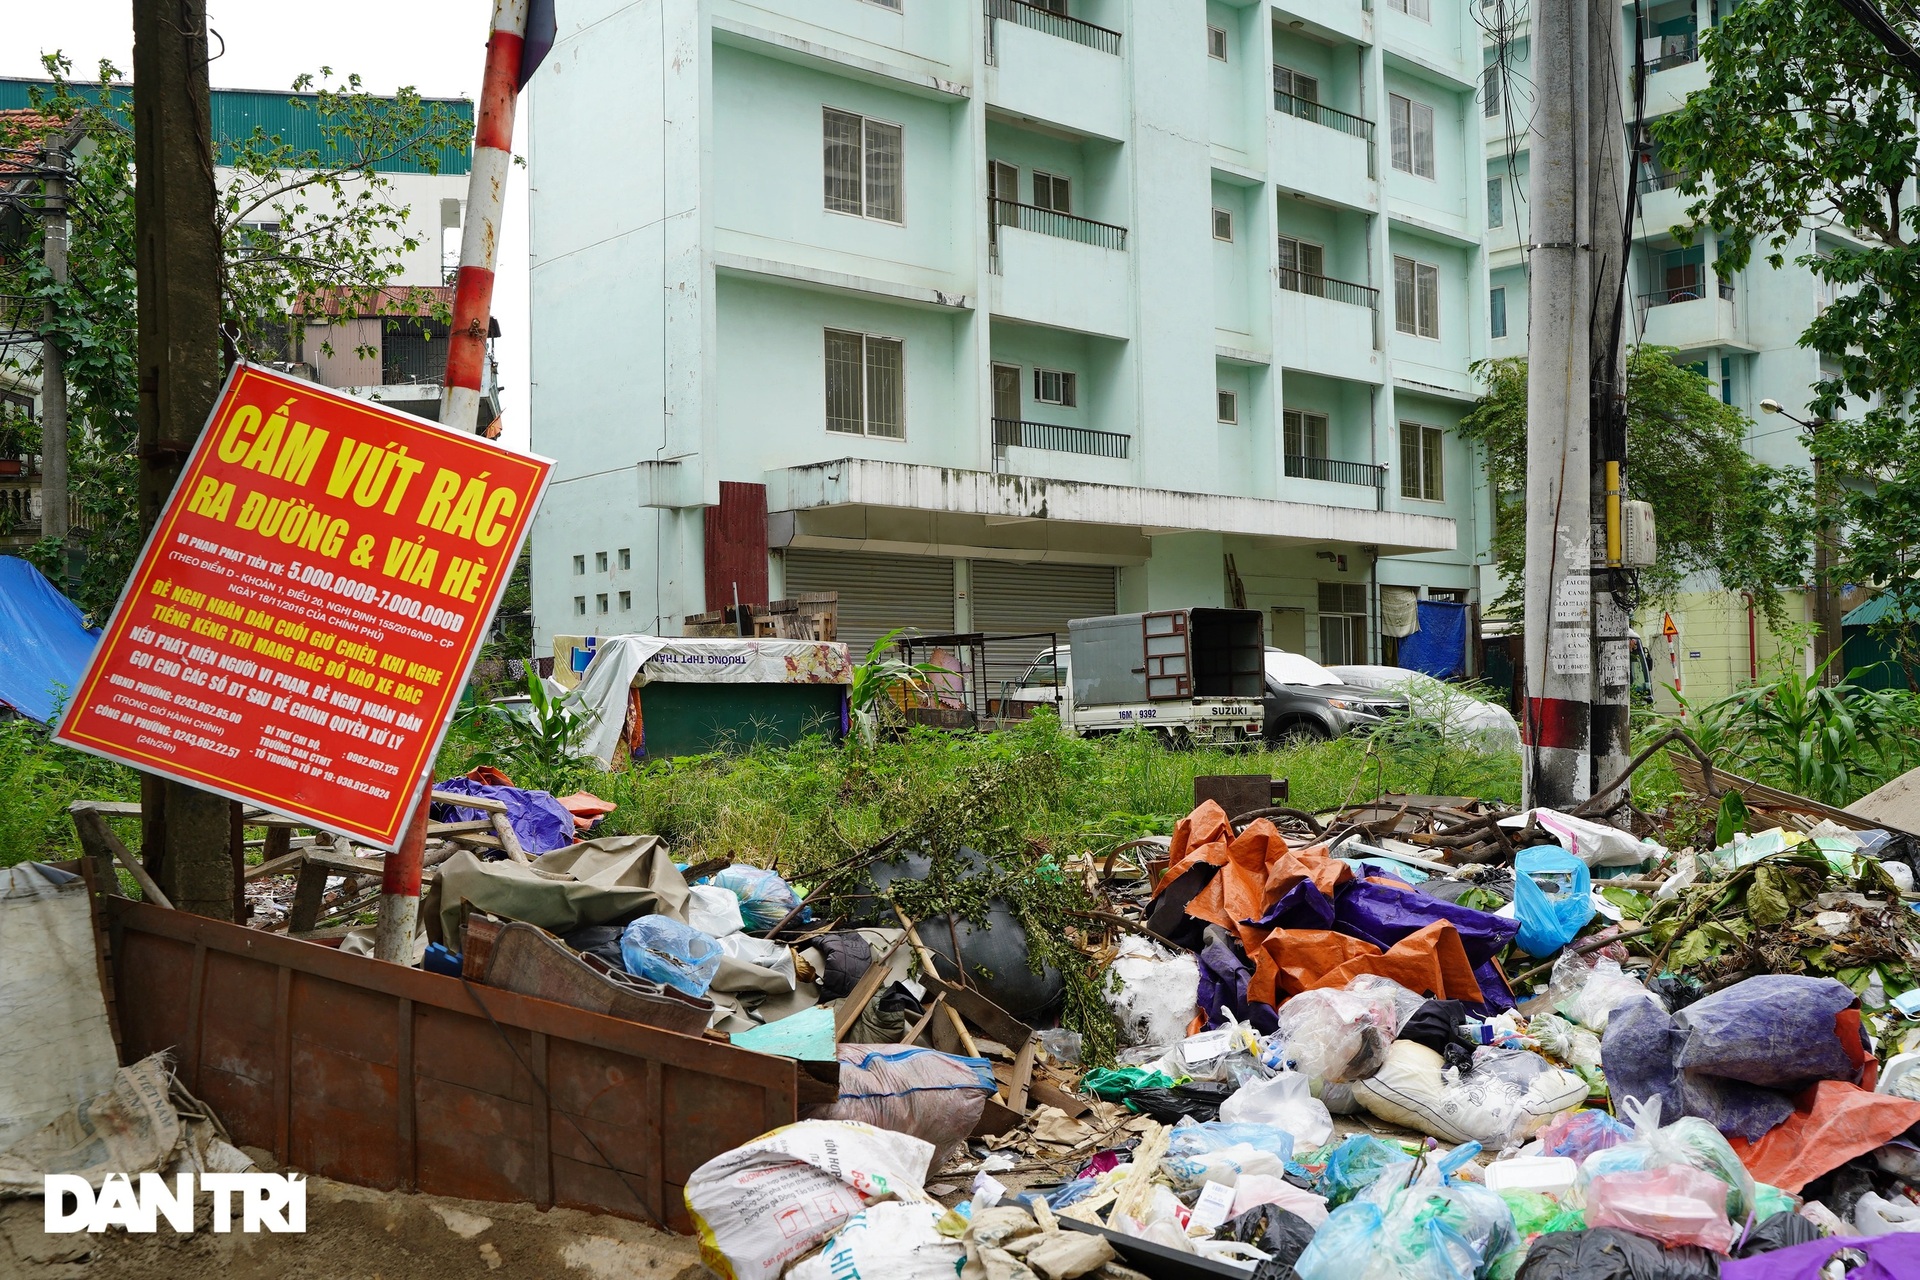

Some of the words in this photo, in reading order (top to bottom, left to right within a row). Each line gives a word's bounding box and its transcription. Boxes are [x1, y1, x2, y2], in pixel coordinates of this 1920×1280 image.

[217, 397, 330, 487] CẤM
[325, 436, 426, 516] VỨT
[415, 467, 518, 548] RÁC
[186, 475, 237, 523] RA
[234, 490, 350, 559] ĐƯỜNG
[349, 533, 376, 570] &
[381, 534, 440, 589] VỈA
[438, 555, 489, 604] HÈ
[168, 550, 200, 566] (THEO
[200, 560, 226, 575] ĐIỂM
[225, 568, 235, 578] D
[240, 573, 277, 591] KHOẢN
[277, 585, 285, 596] 1,
[286, 588, 312, 603] ĐIỀU
[310, 596, 324, 609] 20,
[326, 601, 352, 618] NGHỊ
[351, 609, 378, 624] ĐỊNH
[378, 618, 434, 642] 155/2016/NĐ
[439, 638, 455, 649] CP
[176, 532, 190, 545] VI
[188, 536, 219, 555] PHẠM
[217, 546, 246, 563] PHẠT
[245, 554, 269, 571] TIỀN
[287, 560, 465, 633] 5.000.000Đ-7.000.000Đ
[150, 577, 172, 598] ĐỀ
[170, 585, 207, 612] NGHỊ
[205, 596, 246, 622] NHÂN
[243, 609, 275, 632] DÂN
[274, 619, 310, 643] CUỐI
[335, 639, 378, 667] CHIỀU,
[379, 653, 407, 675] KHI
[405, 661, 444, 687] NGHE
[227, 583, 258, 599] NGÀY
[258, 593, 306, 615] 18/11/2016
[305, 608, 326, 622] CỦA
[327, 616, 360, 633] CHÍNH
[359, 626, 385, 643] PHỦ)
[151, 603, 192, 629] TIẾNG
[190, 616, 229, 642] KẺNG
[228, 628, 255, 650] THÌ
[252, 636, 295, 663] MANG
[294, 650, 325, 672] RÁC
[323, 659, 349, 680] ĐỔ
[346, 666, 376, 689] VÀO
[374, 676, 395, 696] XE
[393, 682, 424, 705] RÁC
[681, 655, 705, 664] THPT
[708, 655, 746, 667] TRƯỜNG
[109, 673, 136, 690] UBND
[173, 694, 243, 724] 0243.862.85.00
[128, 624, 157, 645] NẾU
[154, 633, 190, 660] PHÁT
[185, 644, 219, 666] HIỆN
[217, 654, 259, 679] NGƯỜI
[257, 666, 274, 684] VI
[272, 671, 311, 698] PHẠM,
[311, 683, 331, 702] ĐỀ
[328, 690, 362, 715] NGHỊ
[360, 700, 397, 724] NHÂN
[395, 712, 424, 733] DÂN
[129, 650, 155, 669] GỌI
[153, 657, 186, 678] CHO
[180, 661, 209, 687] CÁC
[207, 674, 229, 695] SỐ
[226, 681, 248, 699] ĐT
[245, 687, 273, 707] SAU
[270, 694, 293, 714] ĐỂ
[288, 701, 330, 727] CHÍNH
[328, 714, 370, 740] QUYỀN
[367, 727, 391, 746] XỬ
[386, 733, 405, 751] LÝ
[94, 704, 121, 720] CÔNG
[119, 712, 135, 725] AN
[172, 729, 241, 759] 0243.862.22.57
[112, 693, 149, 711] (TRONG
[166, 710, 193, 725] HÀNH
[193, 719, 225, 737] CHÍNH)
[1119, 710, 1133, 719] 16M
[1139, 709, 1157, 719] 9392
[1212, 707, 1247, 715] SUZUKI
[136, 734, 177, 754] (24h/24h)
[275, 727, 294, 741] THƯ
[291, 733, 308, 746] CHI
[290, 746, 310, 760] BAN
[308, 752, 333, 767] CTMT
[309, 766, 324, 778] DP
[323, 771, 336, 783] 19:
[346, 751, 400, 776] 0982.057.125
[150, 1099, 177, 1129] NAM
